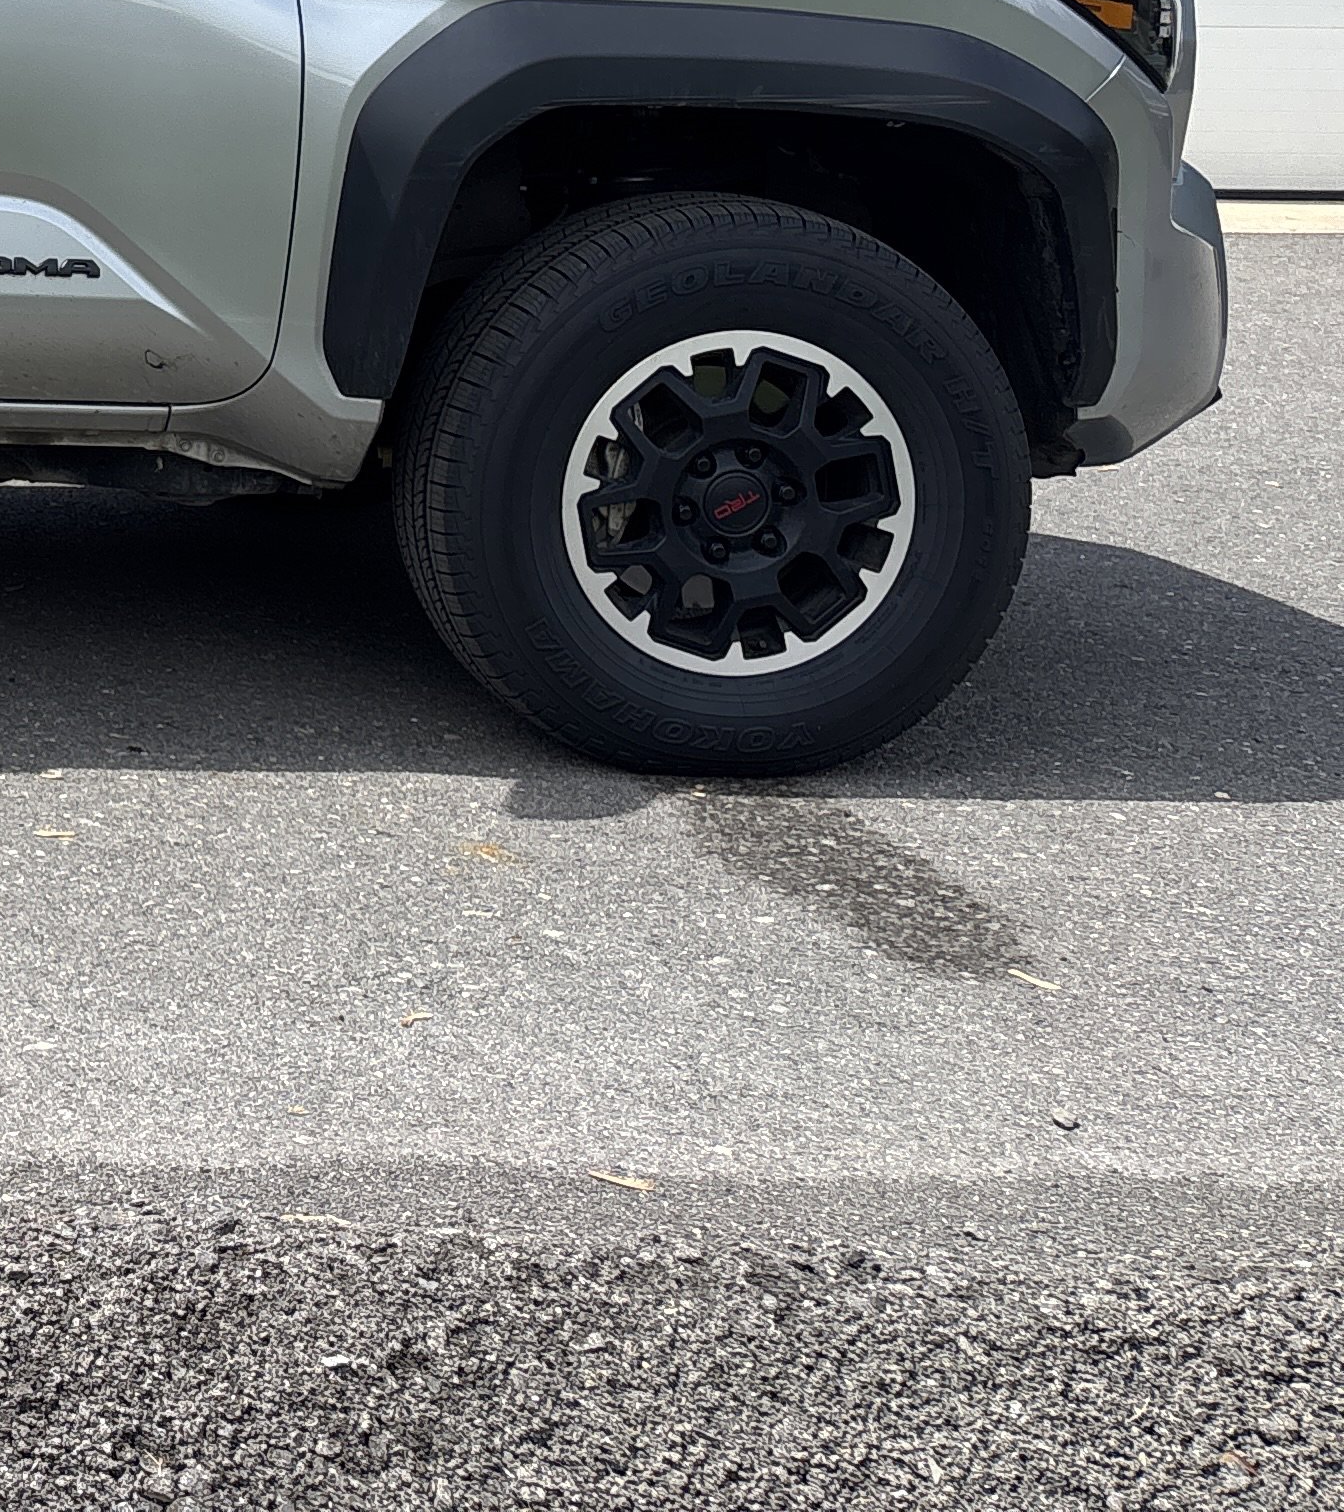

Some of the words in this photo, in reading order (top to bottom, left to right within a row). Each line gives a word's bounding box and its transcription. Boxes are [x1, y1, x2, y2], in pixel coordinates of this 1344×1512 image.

[597, 260, 949, 365] GEOLANDAR
[714, 490, 760, 520] TRD
[525, 616, 818, 752] YOKOHAMA
